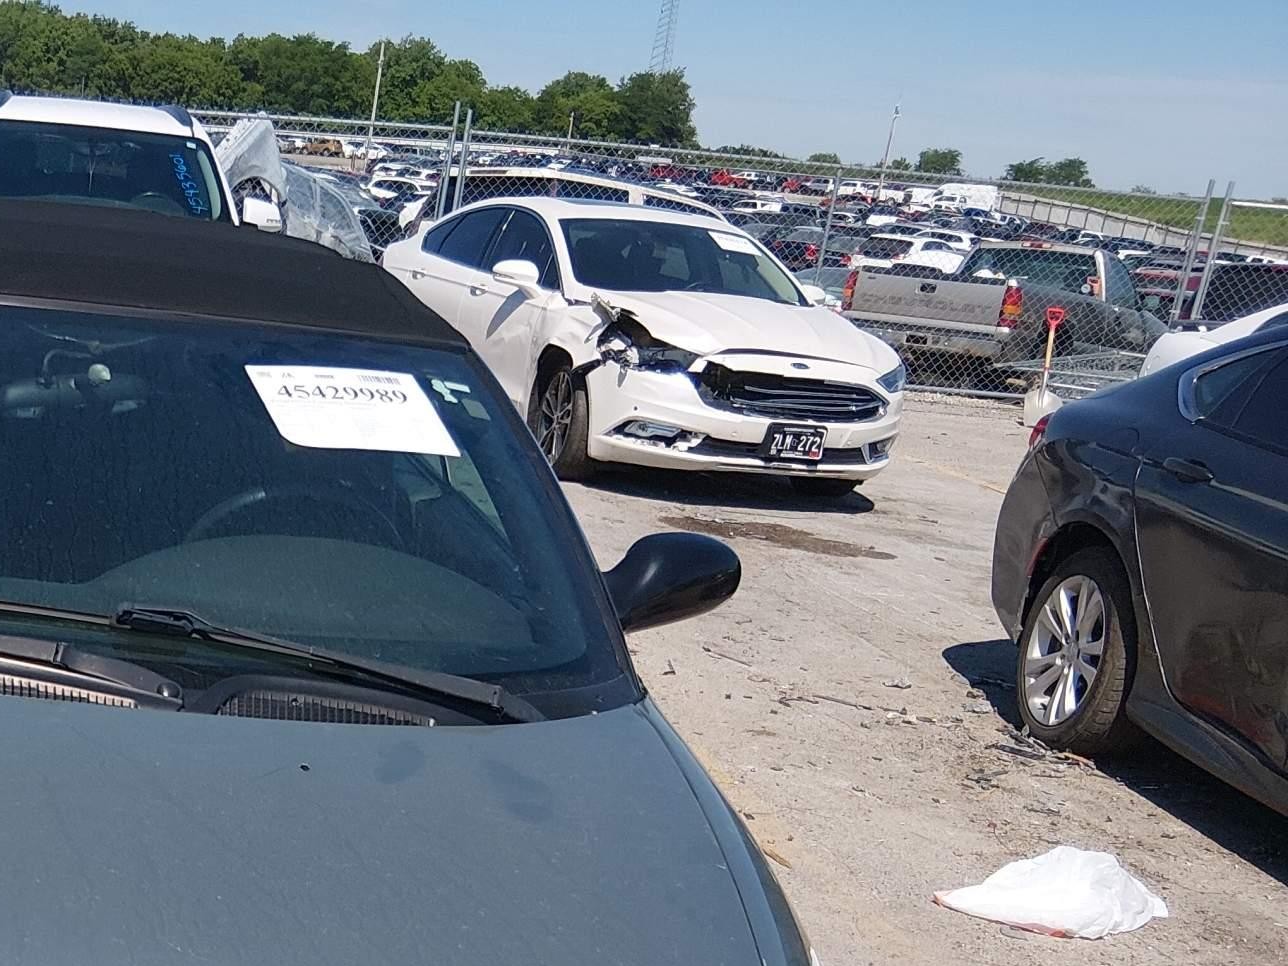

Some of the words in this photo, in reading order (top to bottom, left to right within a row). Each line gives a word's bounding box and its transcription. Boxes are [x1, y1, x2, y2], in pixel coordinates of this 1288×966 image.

[169, 153, 208, 214] 45435601
[277, 385, 408, 404] 45429989
[797, 435, 821, 453] 272
